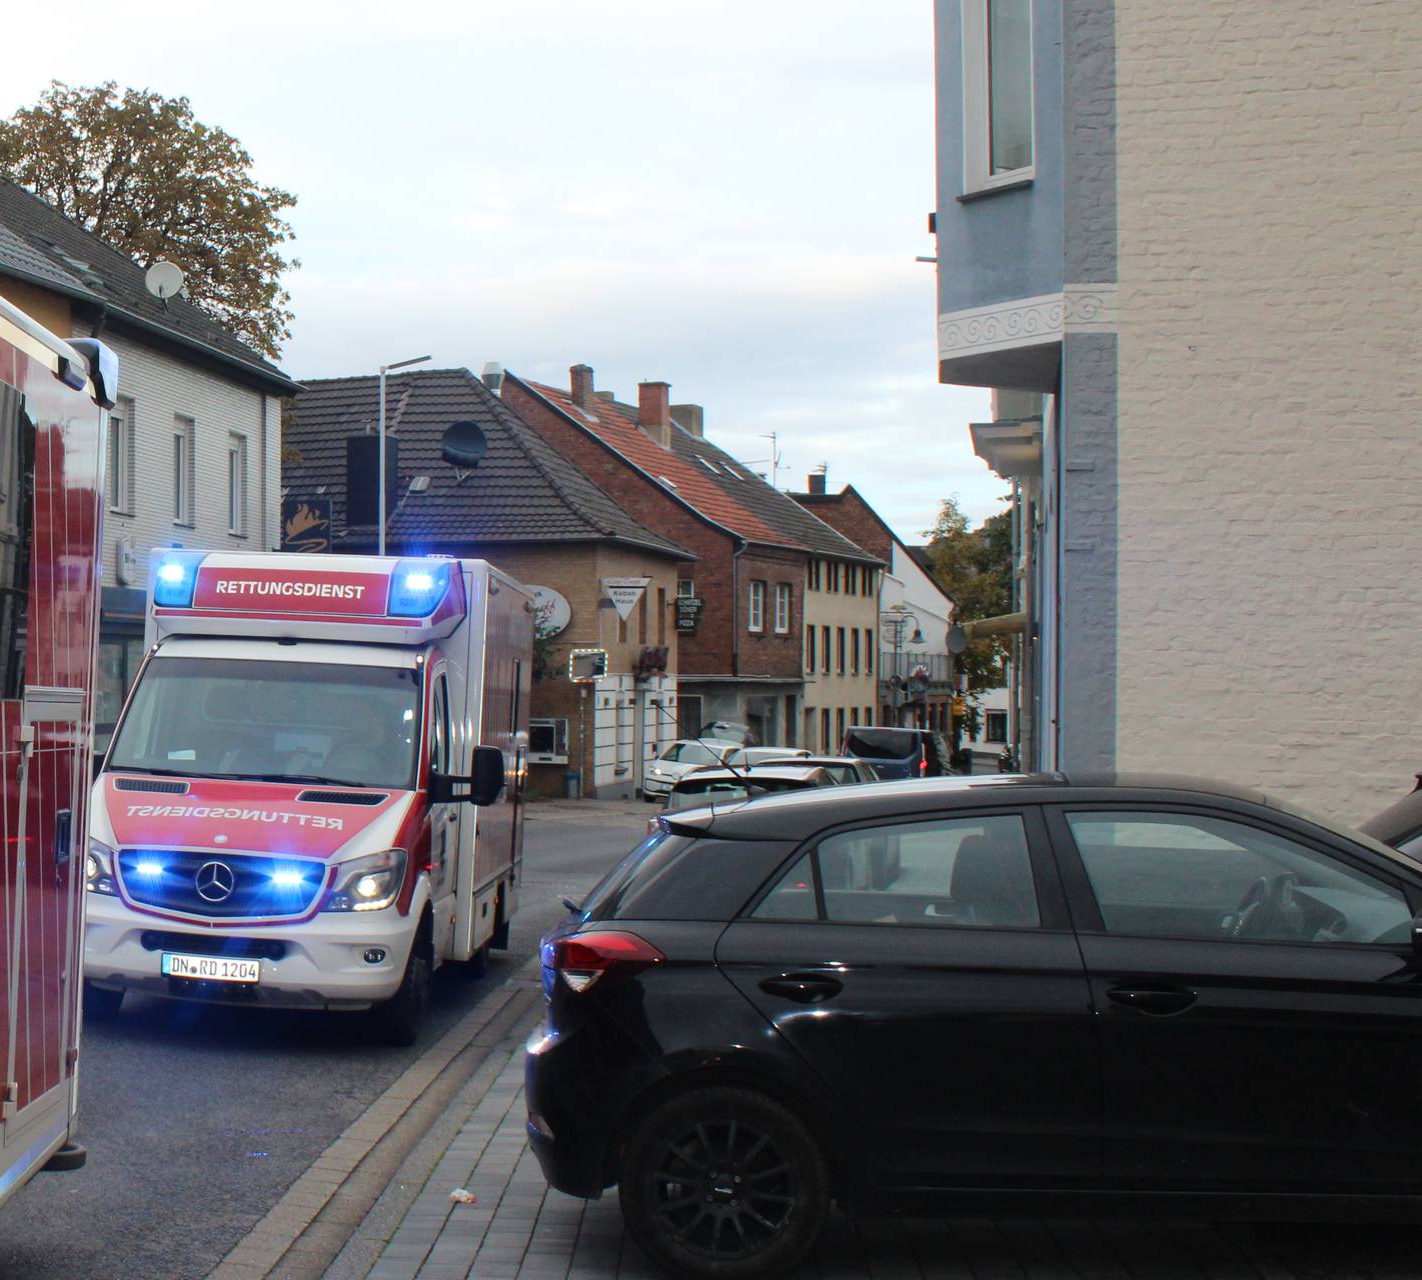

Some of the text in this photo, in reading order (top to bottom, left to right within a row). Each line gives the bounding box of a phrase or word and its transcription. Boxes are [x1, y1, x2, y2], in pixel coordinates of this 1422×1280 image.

[216, 579, 365, 600] RETTUNGSDIENST
[172, 957, 256, 979] DN RD 1204
